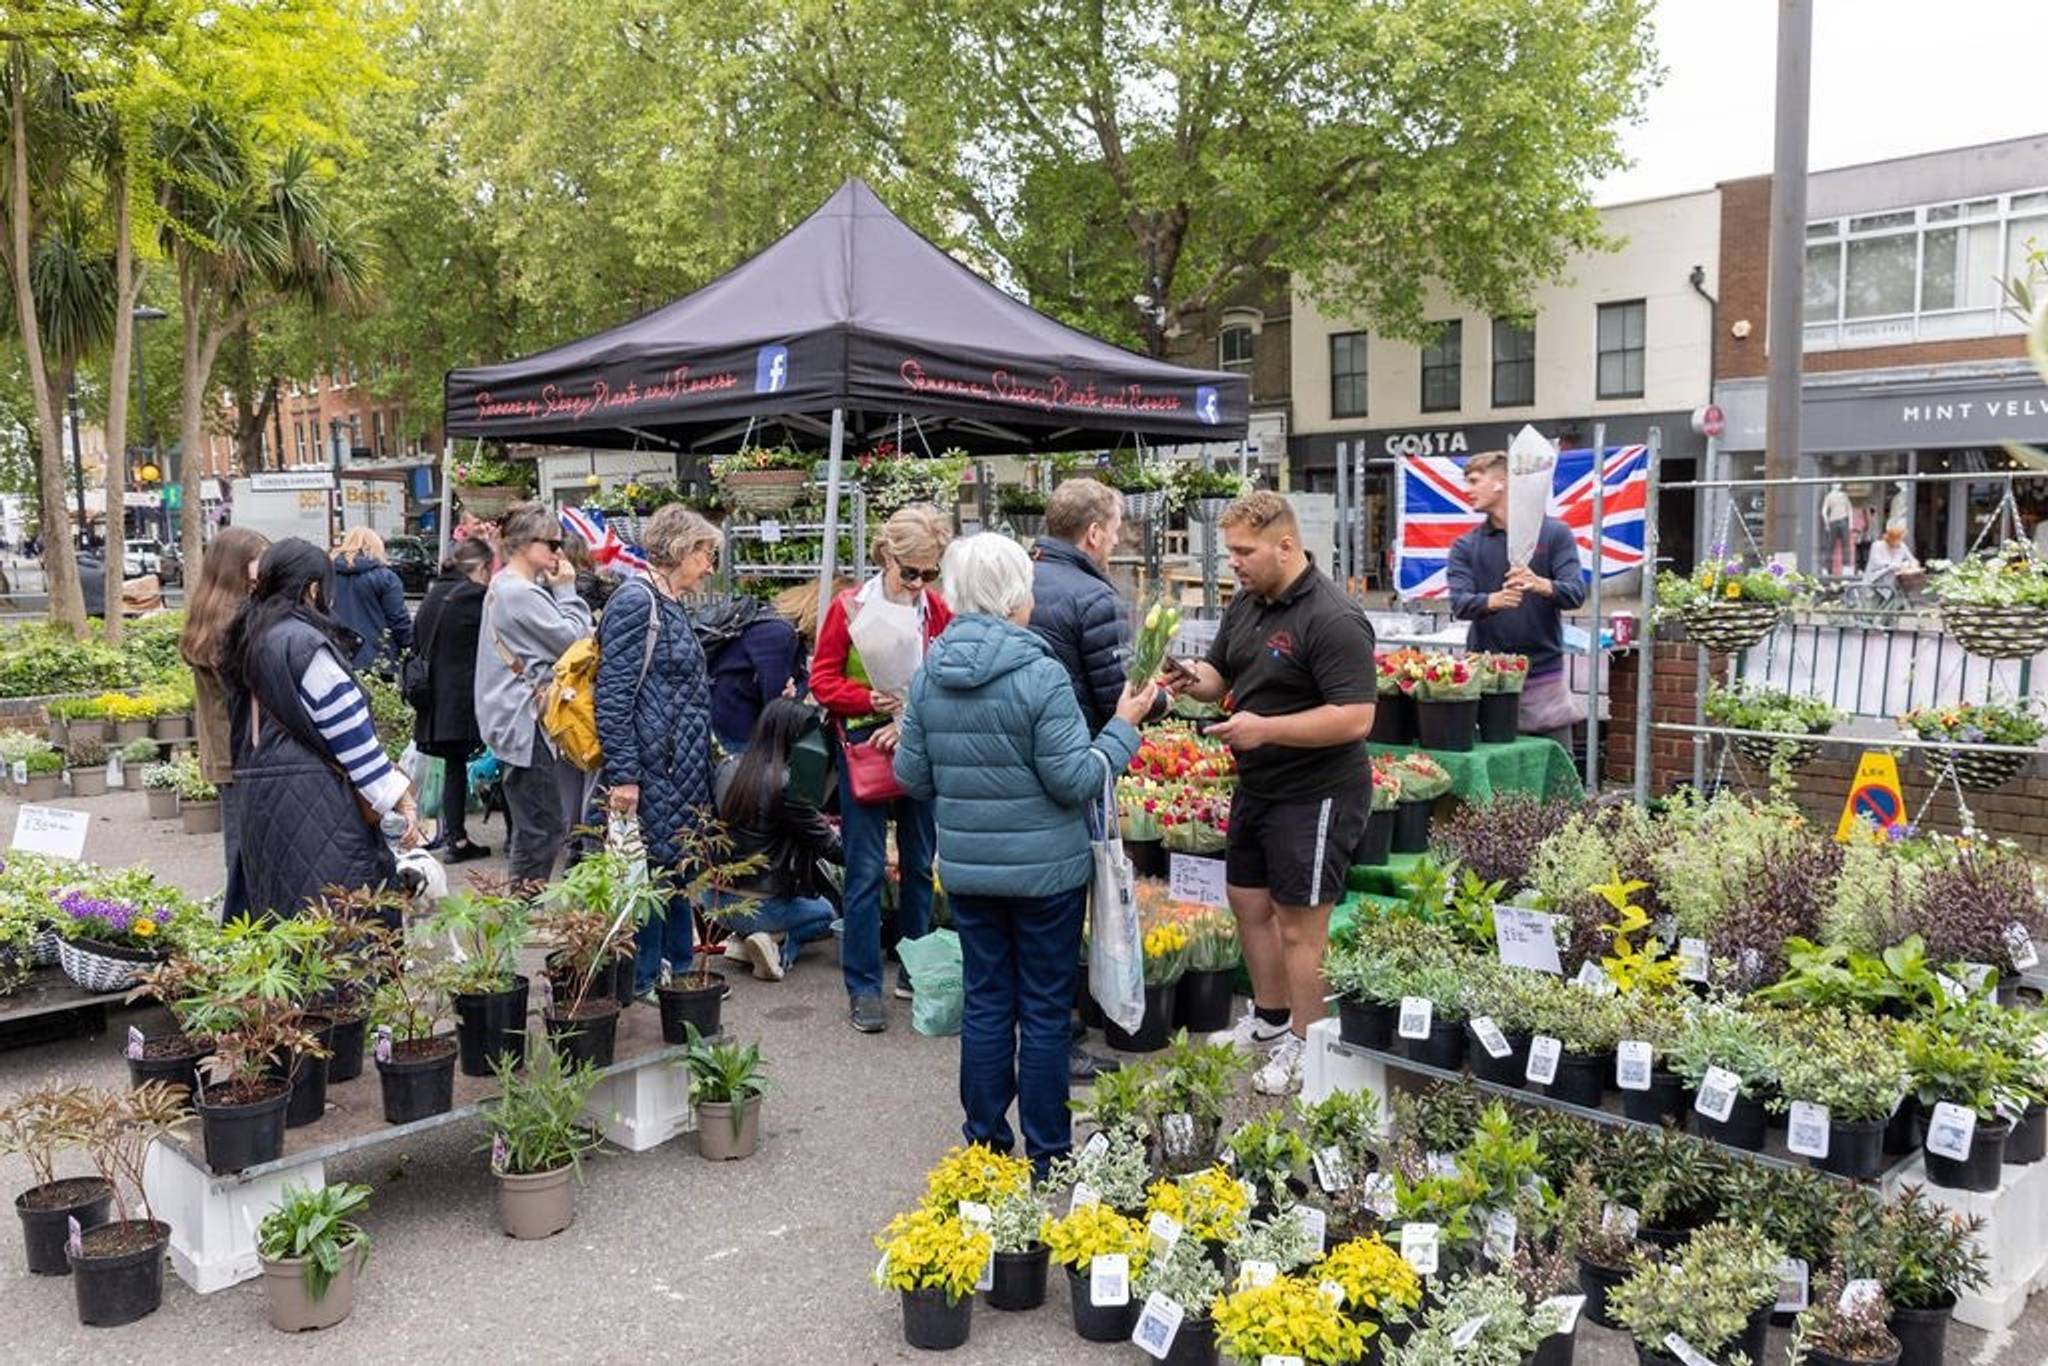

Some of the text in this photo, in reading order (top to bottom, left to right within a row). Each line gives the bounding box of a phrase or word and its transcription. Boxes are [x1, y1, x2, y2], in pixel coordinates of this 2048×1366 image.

[590, 380, 640, 412] Plants
[644, 372, 671, 399] and
[671, 366, 737, 400] Flowers
[1049, 375, 1099, 408] Plants
[1102, 386, 1128, 410] and
[1903, 403, 1972, 422] MINT
[1385, 431, 1468, 455] COSTA
